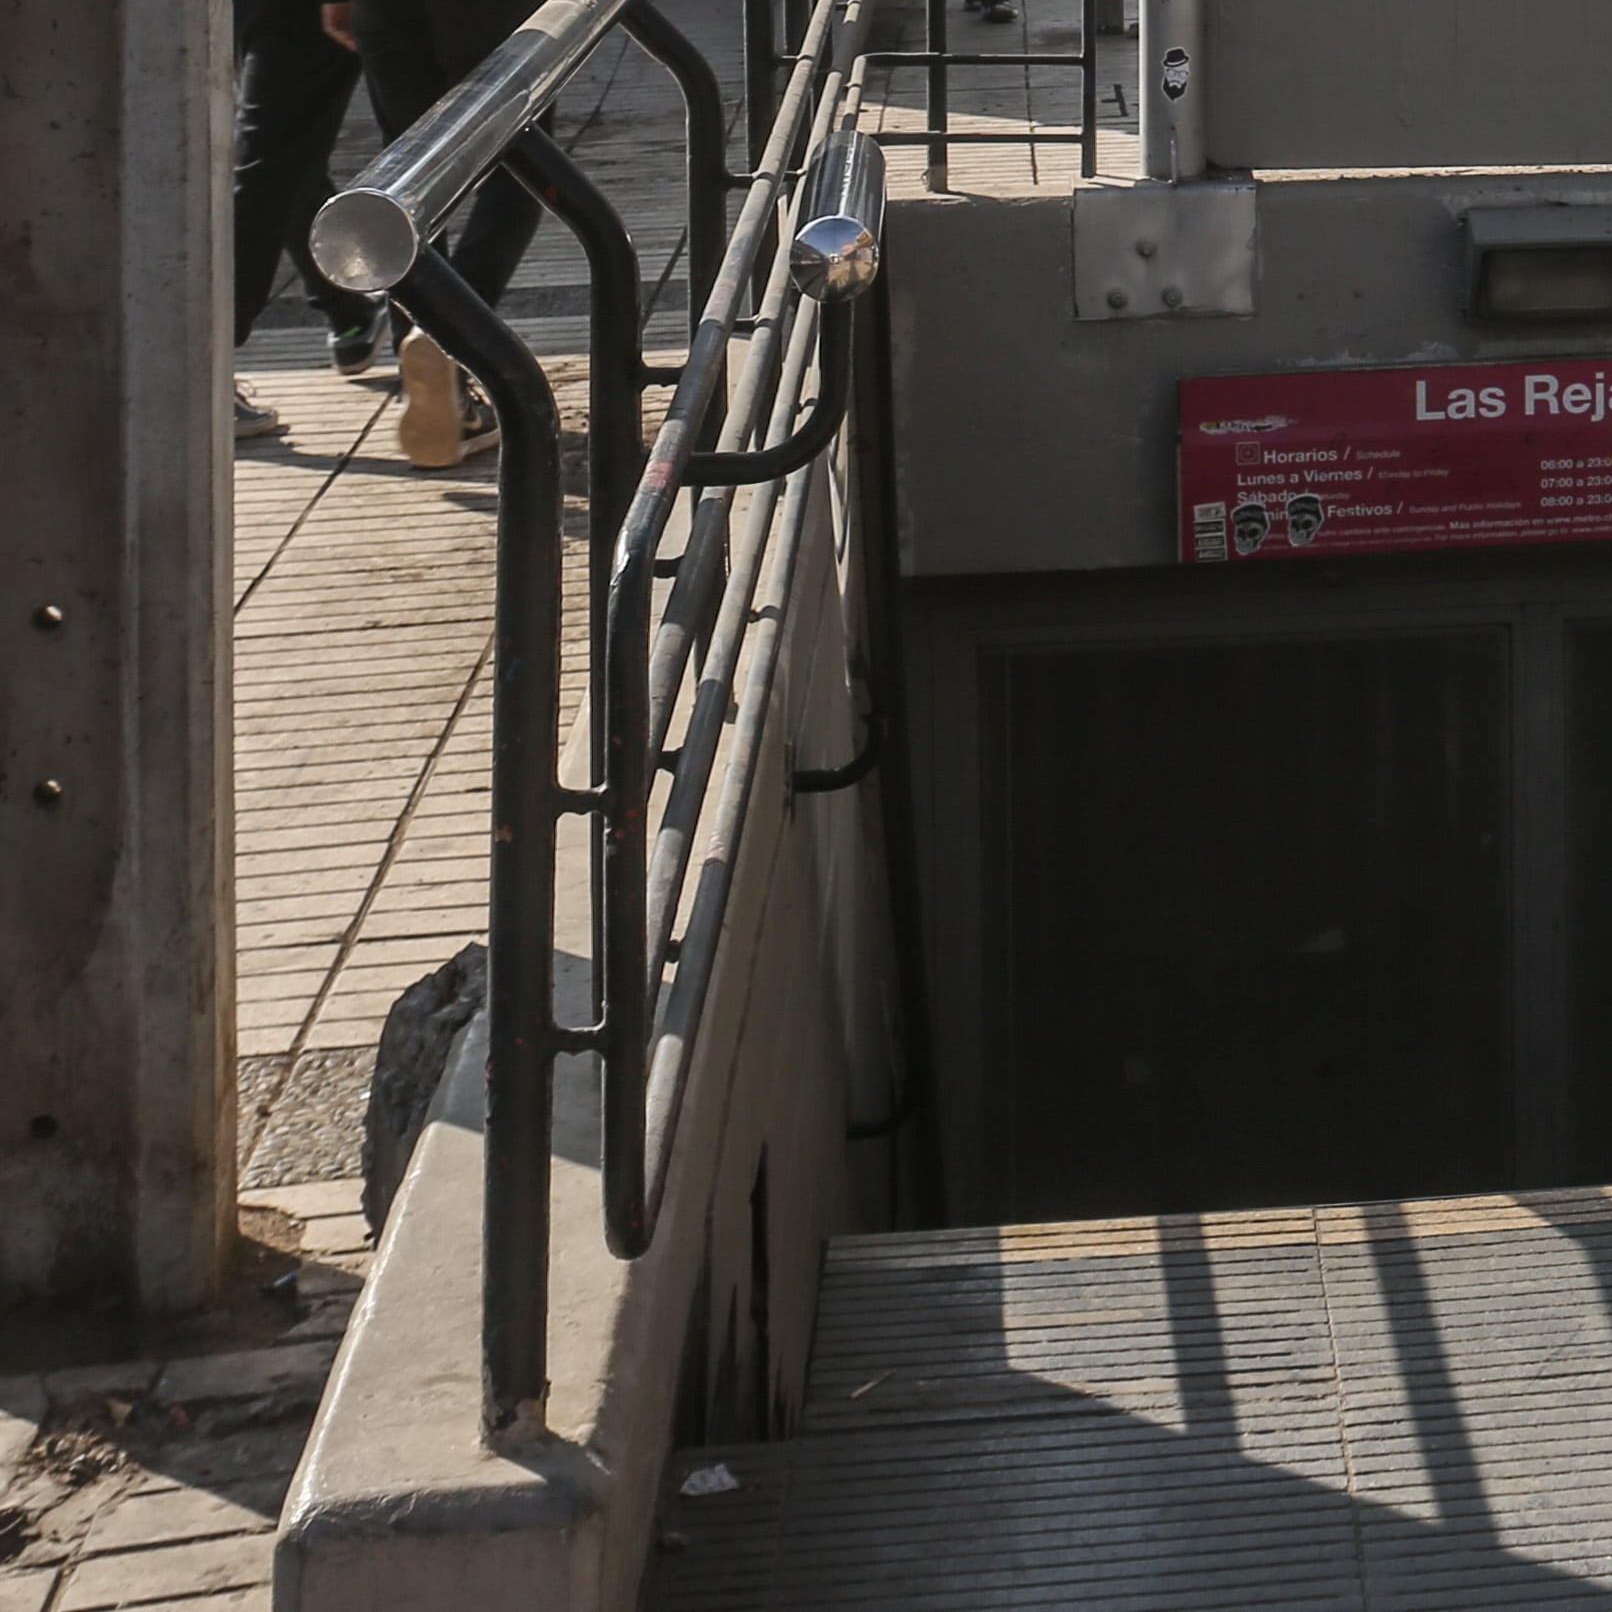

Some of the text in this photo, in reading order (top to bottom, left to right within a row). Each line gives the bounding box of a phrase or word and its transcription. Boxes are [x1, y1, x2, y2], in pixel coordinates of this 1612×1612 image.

[1415, 378, 1507, 422] Las
[1263, 447, 1339, 465] Horarios
[1540, 458, 1574, 471] 06:00
[1237, 468, 1363, 487] Lunes a Viernes
[1540, 476, 1574, 490] 07:00
[1326, 503, 1393, 519] Festivos
